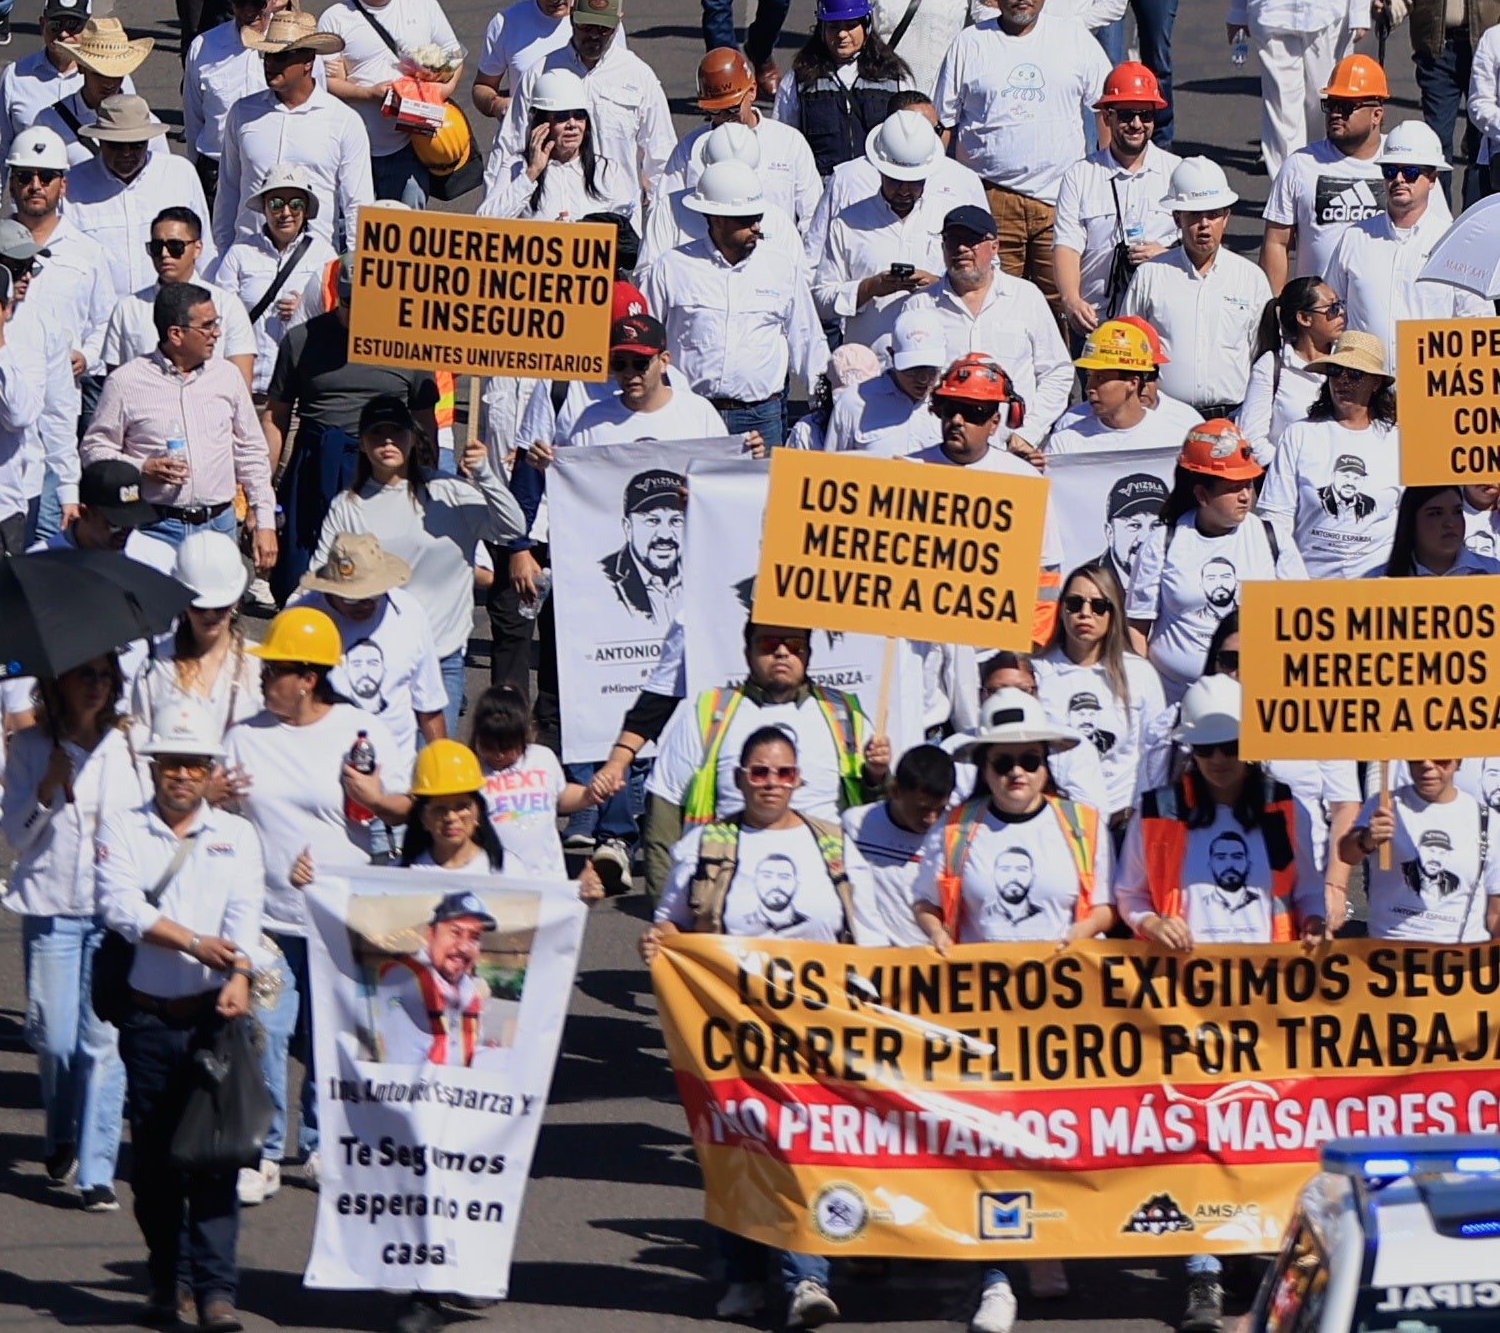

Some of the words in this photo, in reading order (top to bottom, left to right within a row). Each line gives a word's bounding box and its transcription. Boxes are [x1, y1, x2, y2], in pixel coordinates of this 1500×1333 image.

[1322, 205, 1386, 222] adidas
[363, 221, 400, 253] NO
[410, 226, 562, 266] QUEREMOS
[573, 234, 612, 269] UN
[359, 257, 469, 296] FUTURO
[479, 269, 610, 305] INCIERTO
[399, 298, 413, 327] E
[422, 300, 564, 339] INSEGURO
[352, 337, 462, 364] ESTUDIANTES
[467, 349, 602, 373] UNIVERSITARIOS
[1418, 331, 1462, 364] ¡NO
[1428, 363, 1483, 397] MÁS
[801, 478, 858, 514] LOS
[869, 485, 1012, 532] MINEROS
[804, 523, 999, 575] MERECEMOS
[776, 564, 892, 608] VOLVER
[901, 579, 921, 612] A
[934, 582, 1017, 623] CASA
[595, 644, 662, 661] ANTONIO
[486, 769, 546, 794] NEXT
[739, 955, 828, 1013] LOS
[854, 957, 1085, 1016] MINEROS
[1102, 953, 1352, 1009] EXIGIMOS
[704, 1016, 903, 1082] CORRER
[924, 1023, 1143, 1081] PELIGRO
[1162, 1018, 1260, 1077] POR
[779, 1102, 1079, 1159] PERMITAMOS
[1092, 1093, 1194, 1155] MÁS
[1208, 1091, 1456, 1151] MASACRES
[339, 1136, 373, 1166] Te
[466, 1200, 504, 1222] en
[1195, 1201, 1259, 1218] AMSAC
